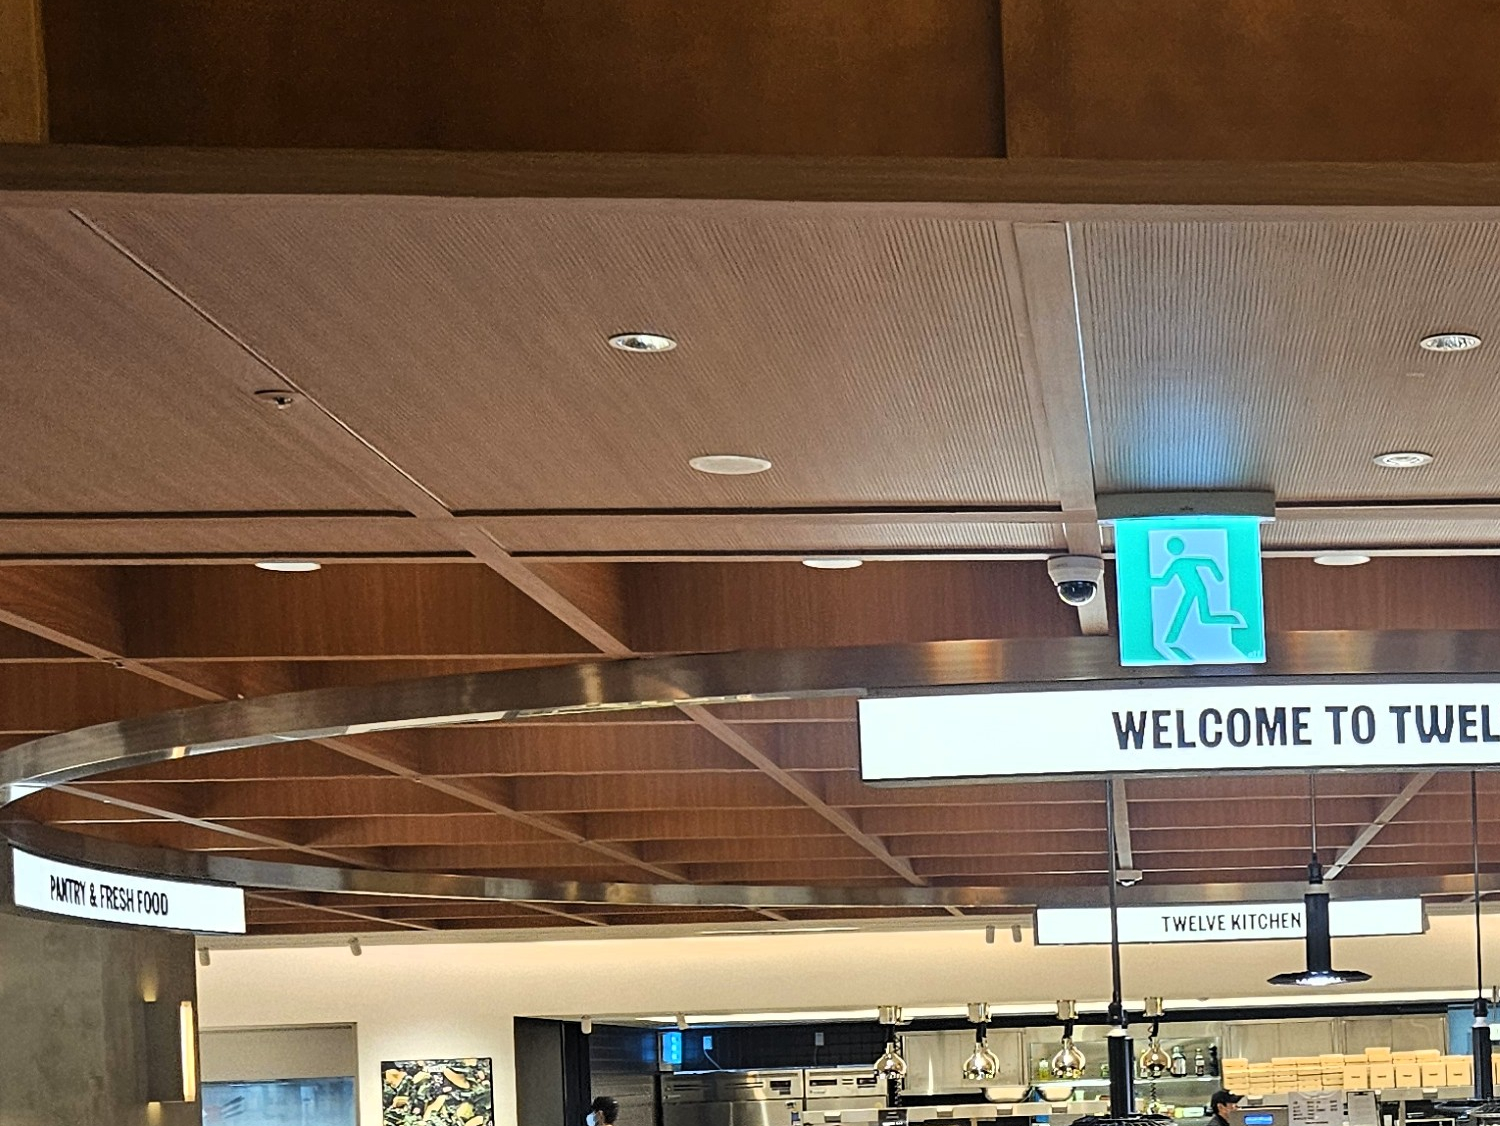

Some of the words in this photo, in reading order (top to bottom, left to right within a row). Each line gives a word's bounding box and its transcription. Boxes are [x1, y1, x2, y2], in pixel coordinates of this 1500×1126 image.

[1112, 707, 1312, 750] WELCOME
[1325, 705, 1376, 745] TO
[50, 875, 86, 906] PANTRY
[90, 882, 98, 908] &
[100, 885, 135, 913] FRESH
[137, 890, 169, 916] FOOD
[1161, 914, 1226, 932] TWELVE
[1231, 912, 1301, 931] KITCHEN
